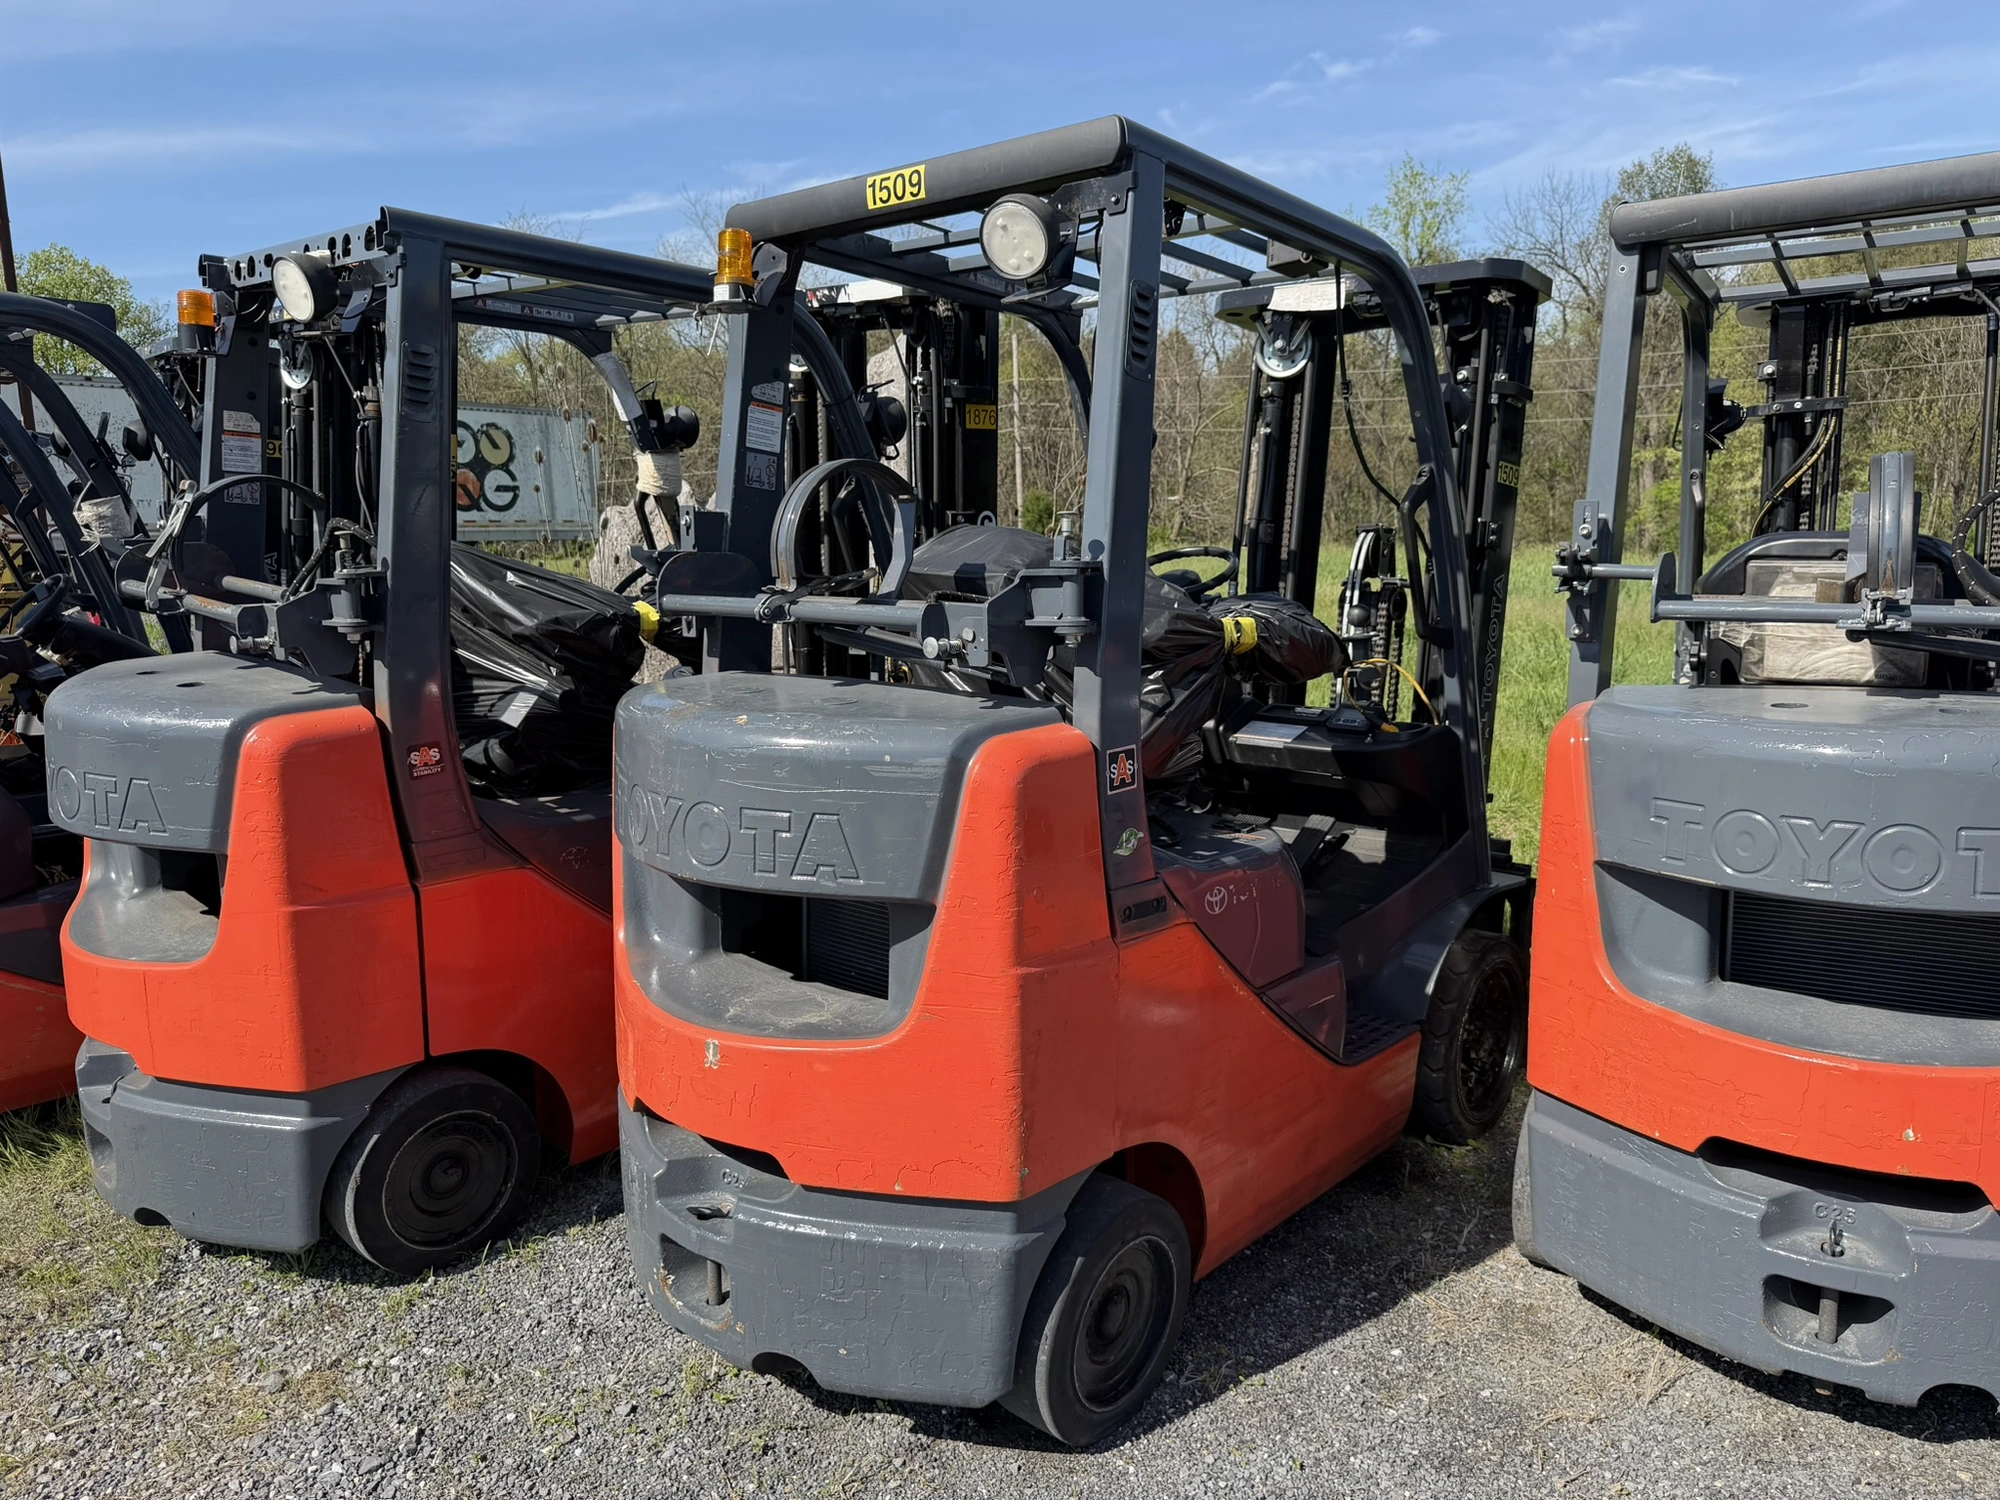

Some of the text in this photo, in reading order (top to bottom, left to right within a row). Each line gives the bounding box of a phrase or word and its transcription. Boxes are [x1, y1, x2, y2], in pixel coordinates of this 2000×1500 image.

[868, 169, 922, 206] 1509
[967, 409, 996, 425] 1876
[1499, 463, 1519, 486] 1509
[1481, 573, 1505, 707] TOYOTA
[410, 746, 441, 766] SAS
[1110, 753, 1137, 786] SAS
[617, 773, 864, 885] TOYOTA
[1812, 1201, 1857, 1225] C25
